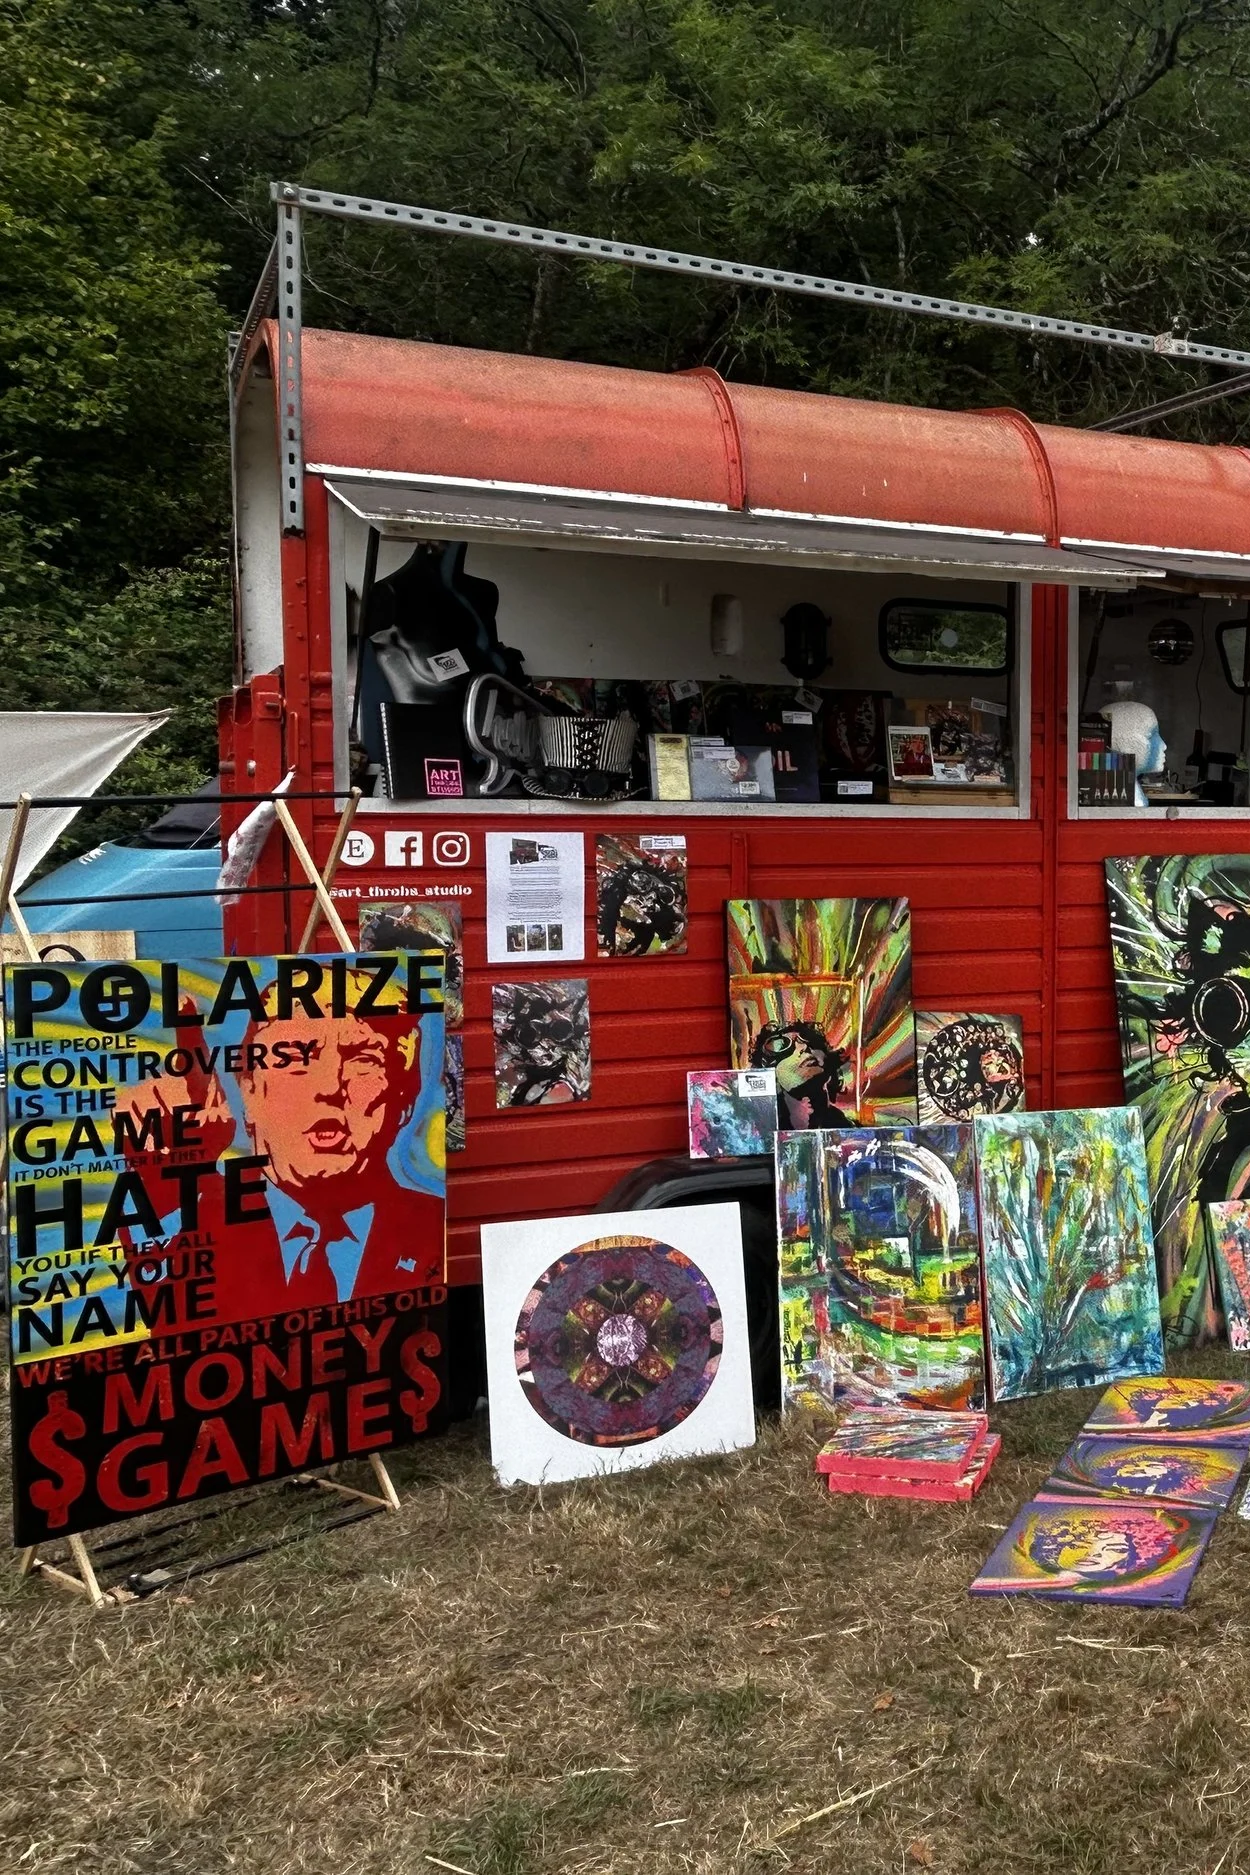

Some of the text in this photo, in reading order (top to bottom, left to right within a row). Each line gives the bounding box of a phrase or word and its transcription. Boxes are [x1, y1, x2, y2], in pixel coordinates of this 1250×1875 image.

[430, 769, 460, 781] ART
[13, 955, 446, 1038] POLARIZE
[13, 1034, 137, 1057] THE PEOPLE
[13, 1039, 321, 1091] CONTROVERSY
[14, 1087, 117, 1119] IS THE
[12, 1104, 204, 1166] GAME
[14, 1148, 208, 1183] IT DON'T MATTER IF THEY
[15, 1154, 272, 1259] HATE
[15, 1231, 217, 1275] YOU IF THEY ALL
[18, 1249, 216, 1307] SAY YOUR
[17, 1285, 449, 1389] WE'RE ALL PART OF THIS OLD
[18, 1276, 218, 1354] NAME
[102, 1316, 398, 1434] MONEY
[96, 1378, 394, 1512] GAME
